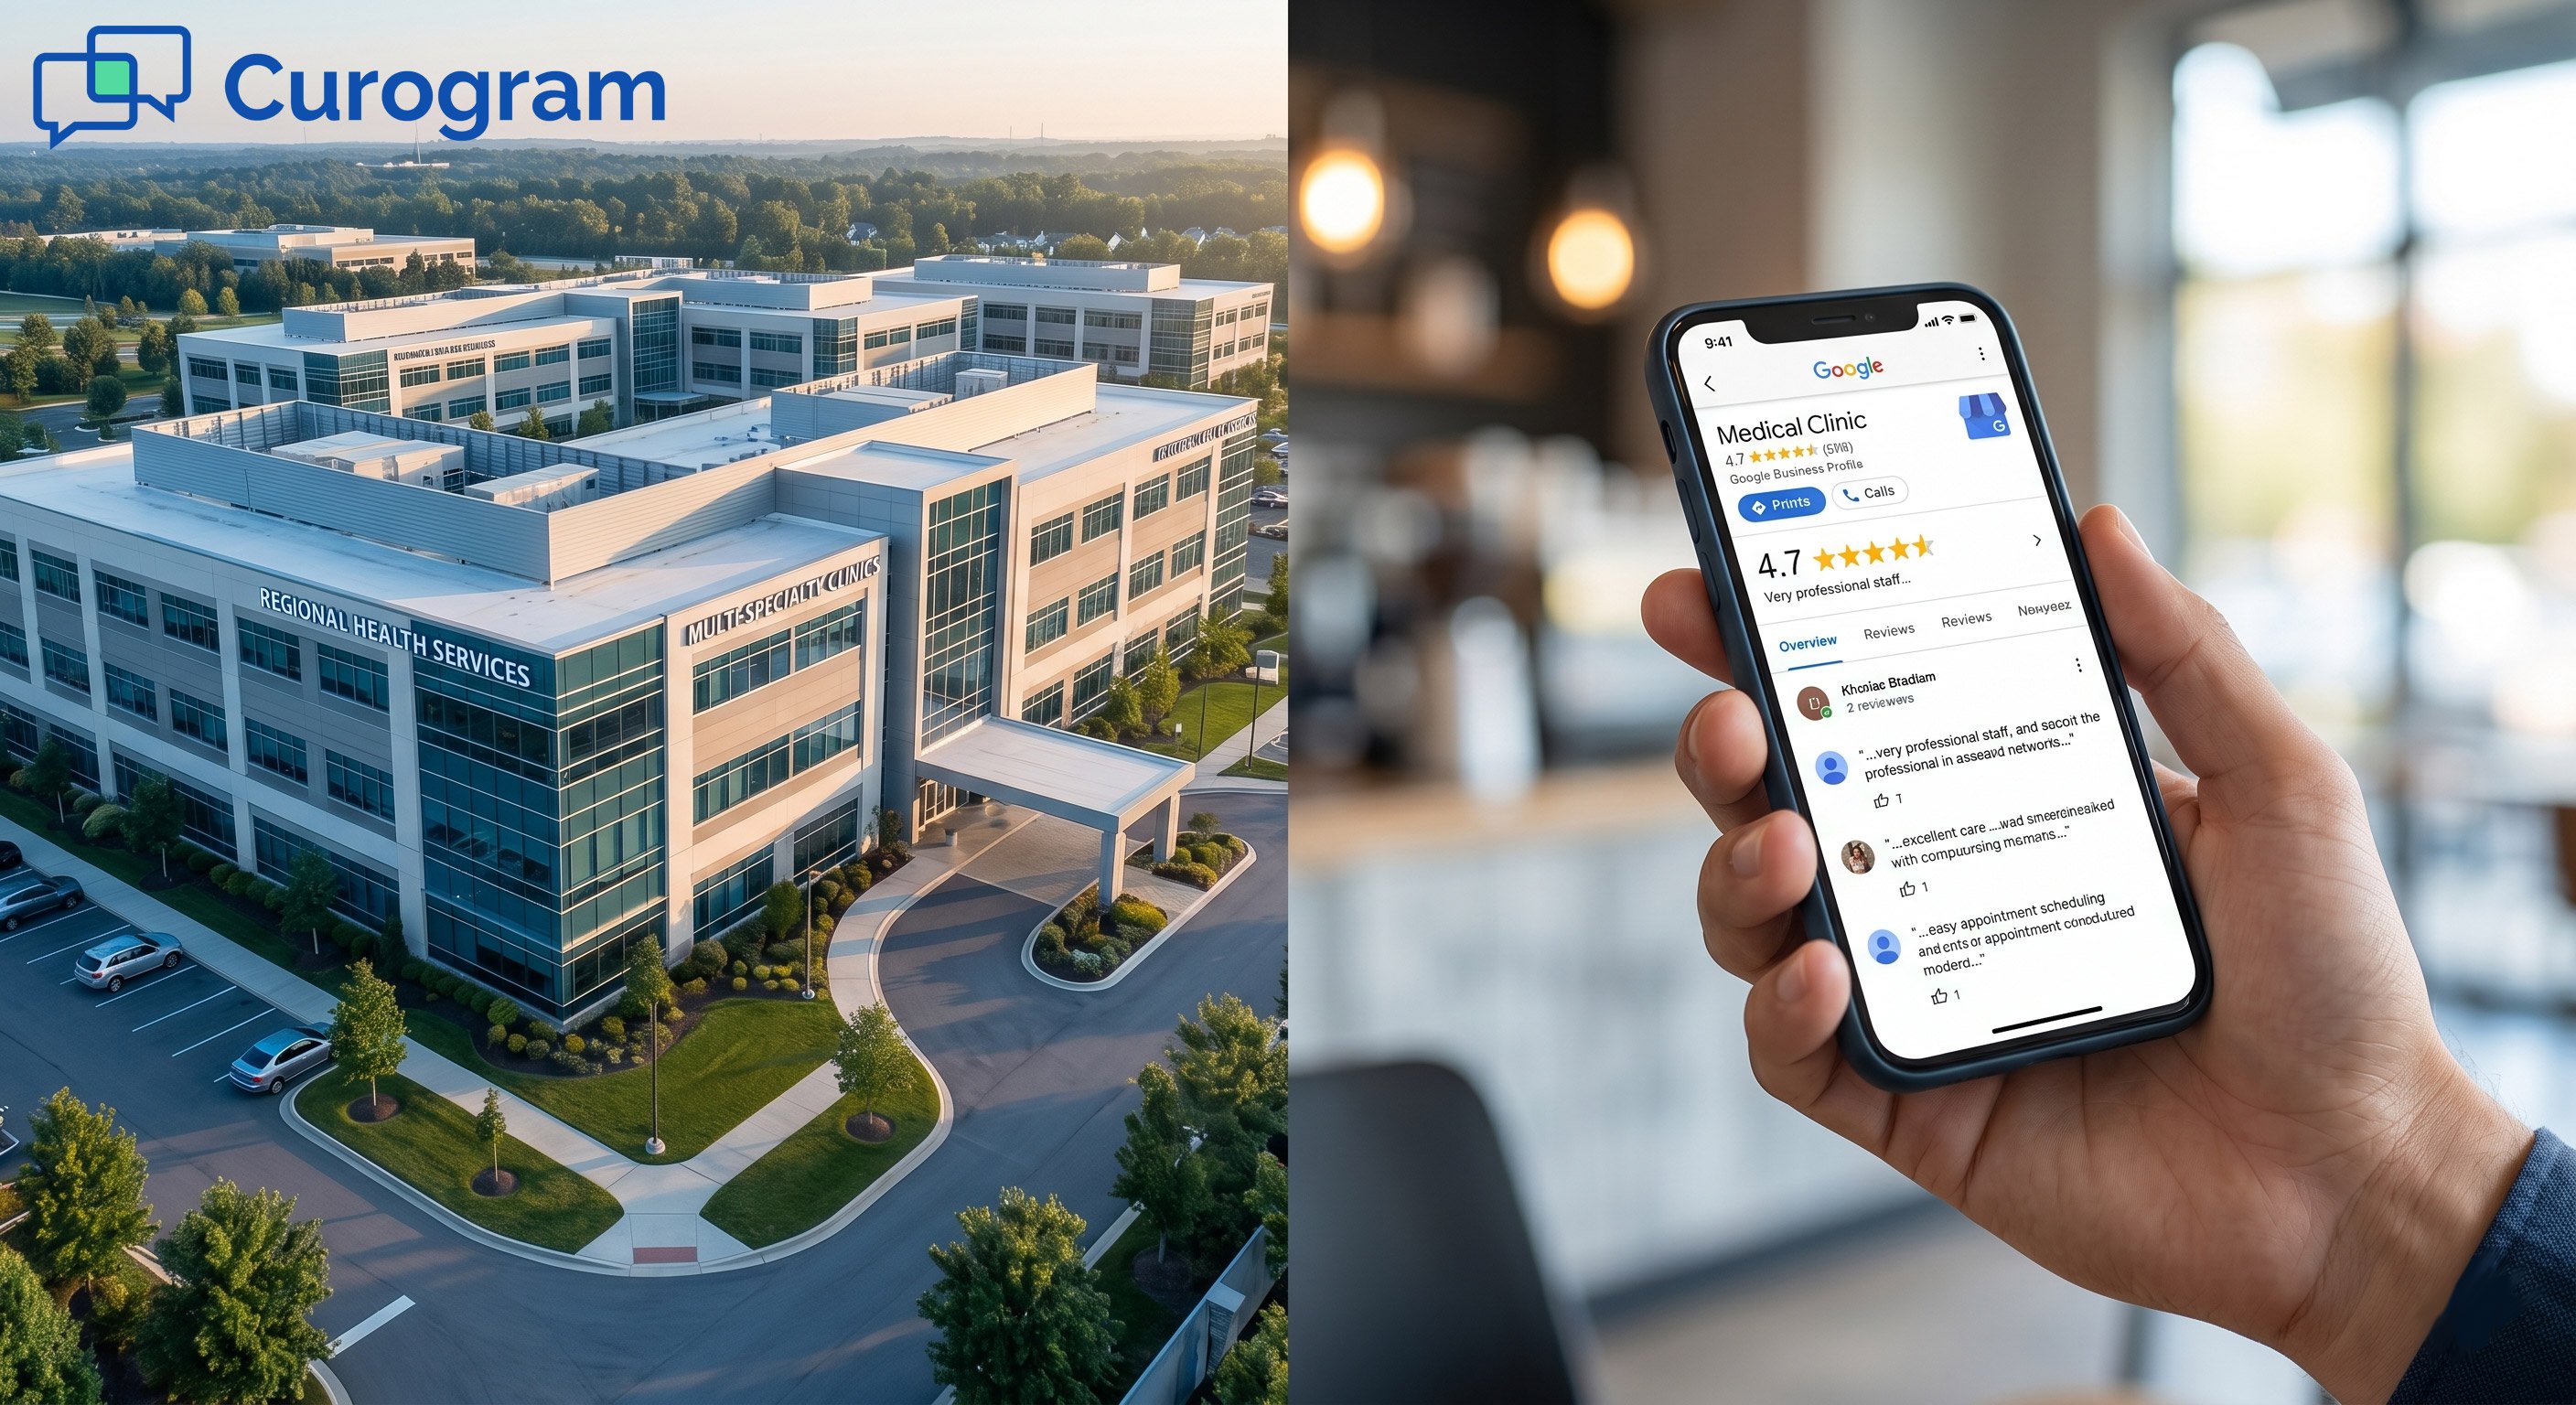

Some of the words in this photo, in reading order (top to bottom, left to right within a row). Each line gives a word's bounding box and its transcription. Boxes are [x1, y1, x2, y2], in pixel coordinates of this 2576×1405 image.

[1704, 336, 1733, 349] 9:41
[1813, 356, 1884, 381] Google
[1717, 416, 1803, 445] Medical
[1807, 411, 1868, 434] Clinic
[1992, 419, 2006, 433] G
[1725, 452, 1744, 467] 4.7
[1730, 471, 1771, 485] Google
[1773, 465, 1825, 479] Business
[1827, 459, 1863, 473] Profile
[1772, 496, 1811, 511] Prints
[1863, 485, 1895, 499] Calls
[1758, 548, 1801, 579] 4.7
[688, 575, 826, 646] MULTI-SPECIALTY
[827, 554, 881, 592] CLINICS
[1764, 591, 1793, 604] Very
[1796, 577, 1871, 602] professional
[259, 586, 349, 633] REGIONAL
[353, 615, 427, 657] HEALTH
[433, 638, 531, 688] SERVICES
[1778, 635, 1838, 653] Overview
[1863, 624, 1916, 640] Reviews
[1941, 612, 1992, 628] Reviews
[1846, 702, 1855, 713] 2
[1905, 730, 1980, 756] professional
[1982, 724, 2013, 741] staff,
[2015, 720, 2039, 735] and
[2080, 712, 2101, 724] the
[1864, 756, 1940, 783] professional
[1941, 754, 1954, 767] in
[1960, 822, 1987, 837] care
[1891, 853, 1918, 869] with
[1922, 881, 1928, 893] 1
[1960, 904, 2038, 932] appointment
[2040, 893, 2106, 915] scheduling
[1918, 942, 1942, 958] and
[1942, 938, 1970, 953] ents
[1970, 936, 1982, 949] or
[1984, 919, 2062, 947] appointment
[1954, 989, 1961, 1001] 1
